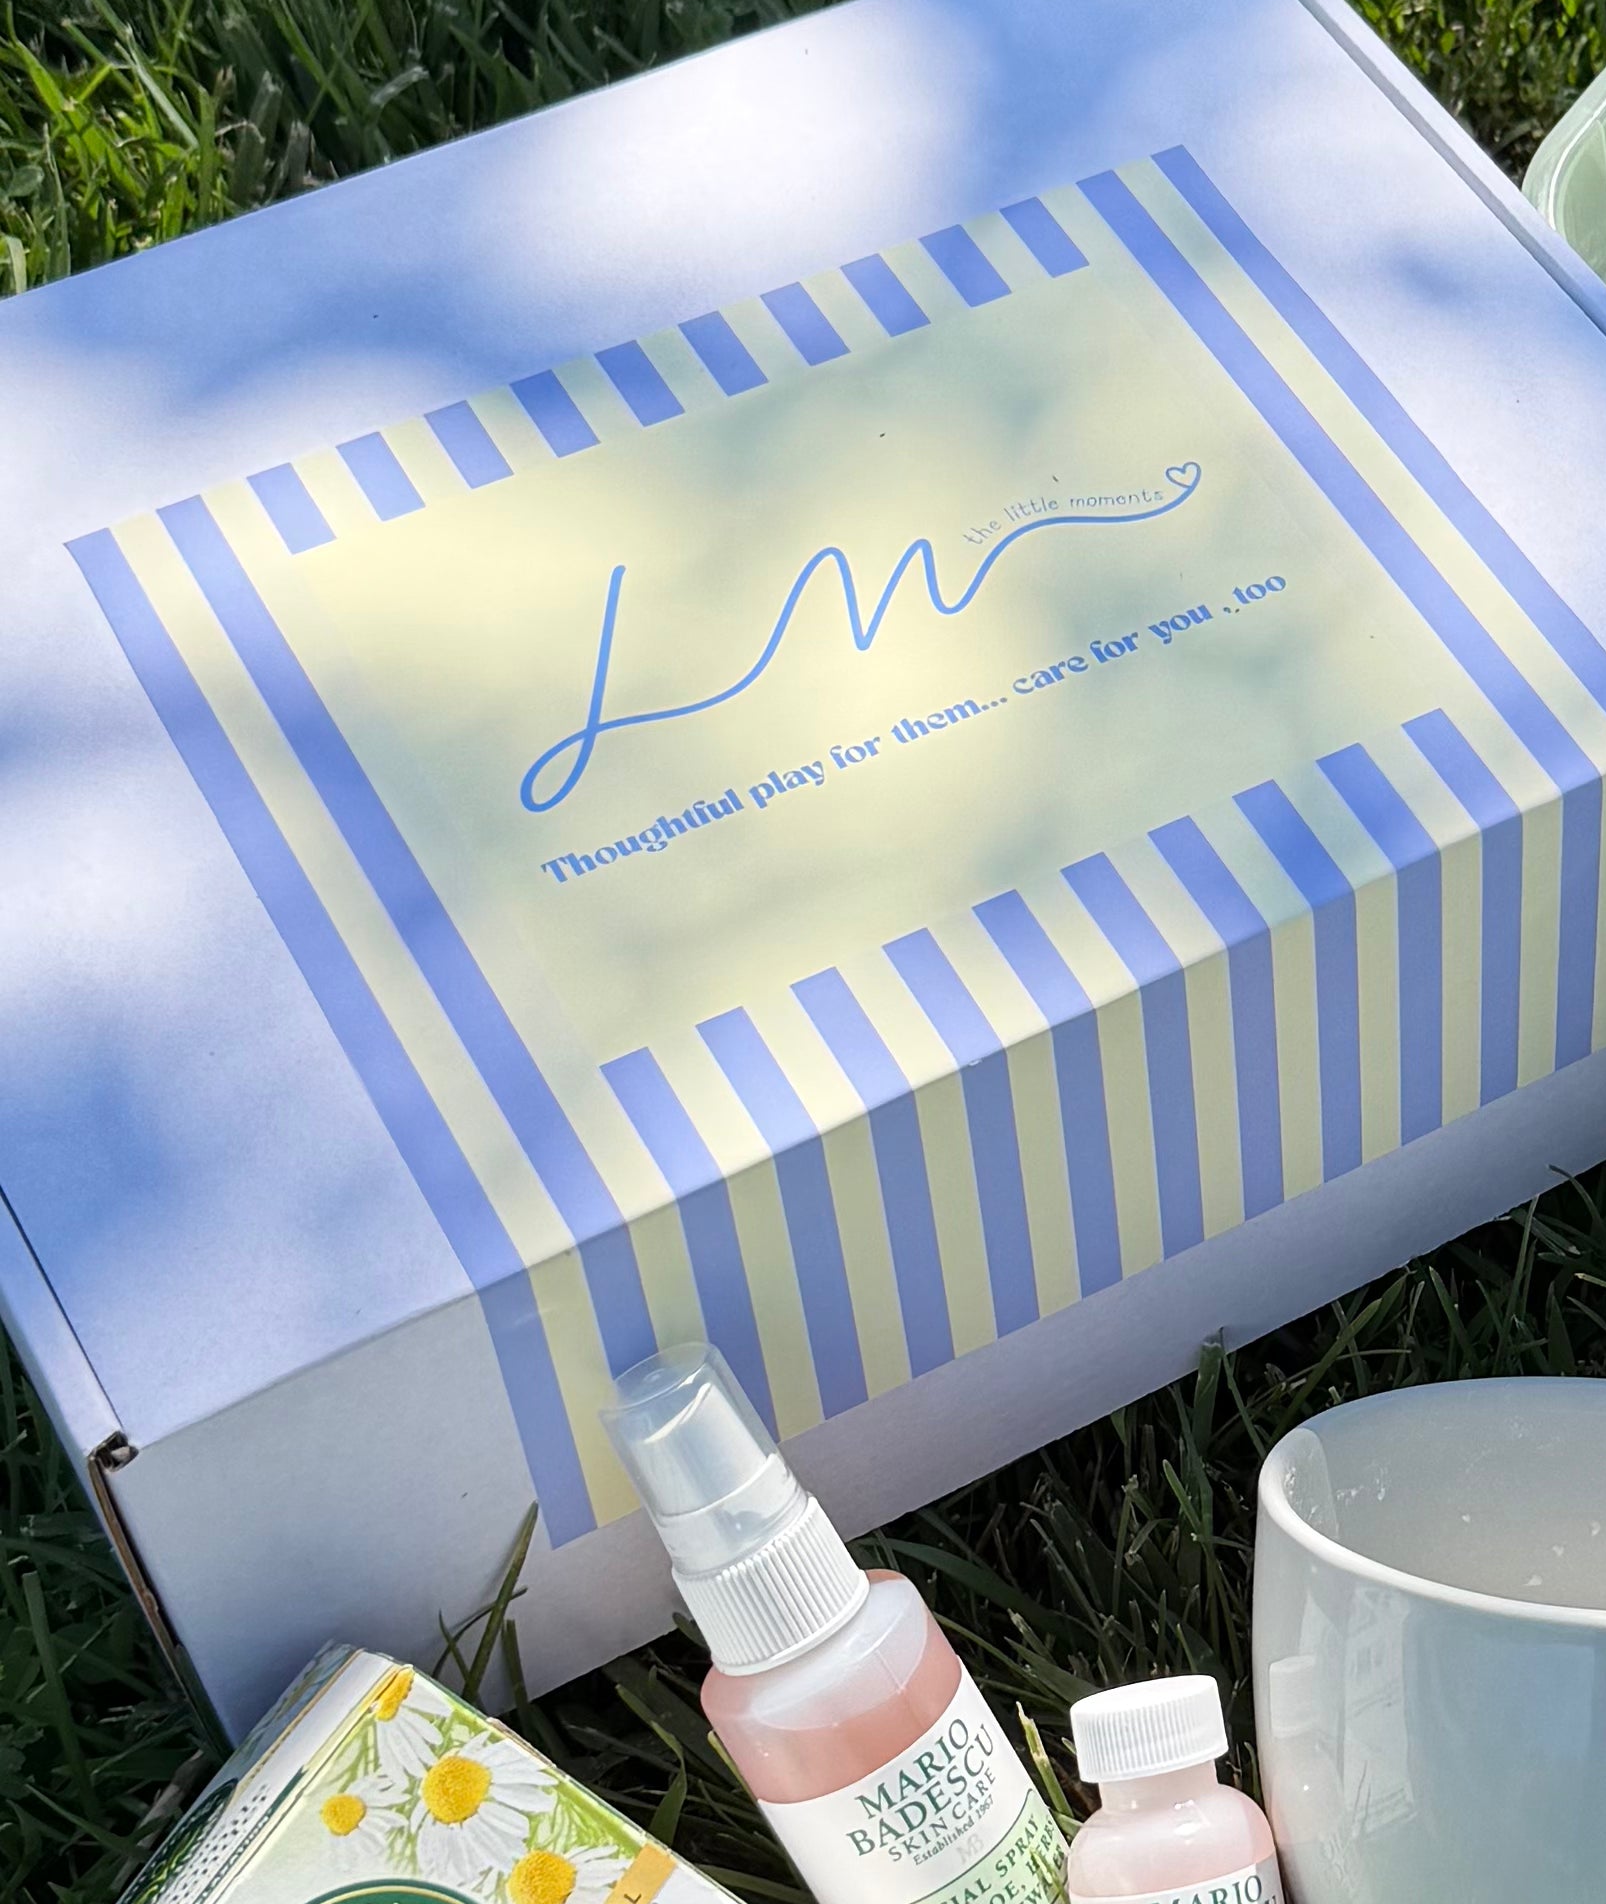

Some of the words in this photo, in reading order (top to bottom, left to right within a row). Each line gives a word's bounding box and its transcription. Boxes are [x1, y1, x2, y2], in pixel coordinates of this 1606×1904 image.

[963, 519, 1002, 546] the
[1004, 496, 1060, 523] little
[1069, 488, 1165, 509] moments
[541, 788, 745, 883] Thoughtful
[748, 760, 825, 809] play
[829, 735, 881, 769] for
[891, 697, 1008, 744] them...
[1013, 655, 1089, 695] care
[1090, 631, 1139, 664] for
[1148, 603, 1214, 645] you
[1232, 575, 1287, 605] too
[846, 1724, 994, 1856] BADESCU
[854, 1718, 969, 1820] MARIO
[888, 1816, 948, 1862] SKIN
[952, 1767, 996, 1820] CARE
[913, 1819, 975, 1866] Established
[976, 1793, 994, 1821] 1967
[995, 1814, 1039, 1878] SPRAY
